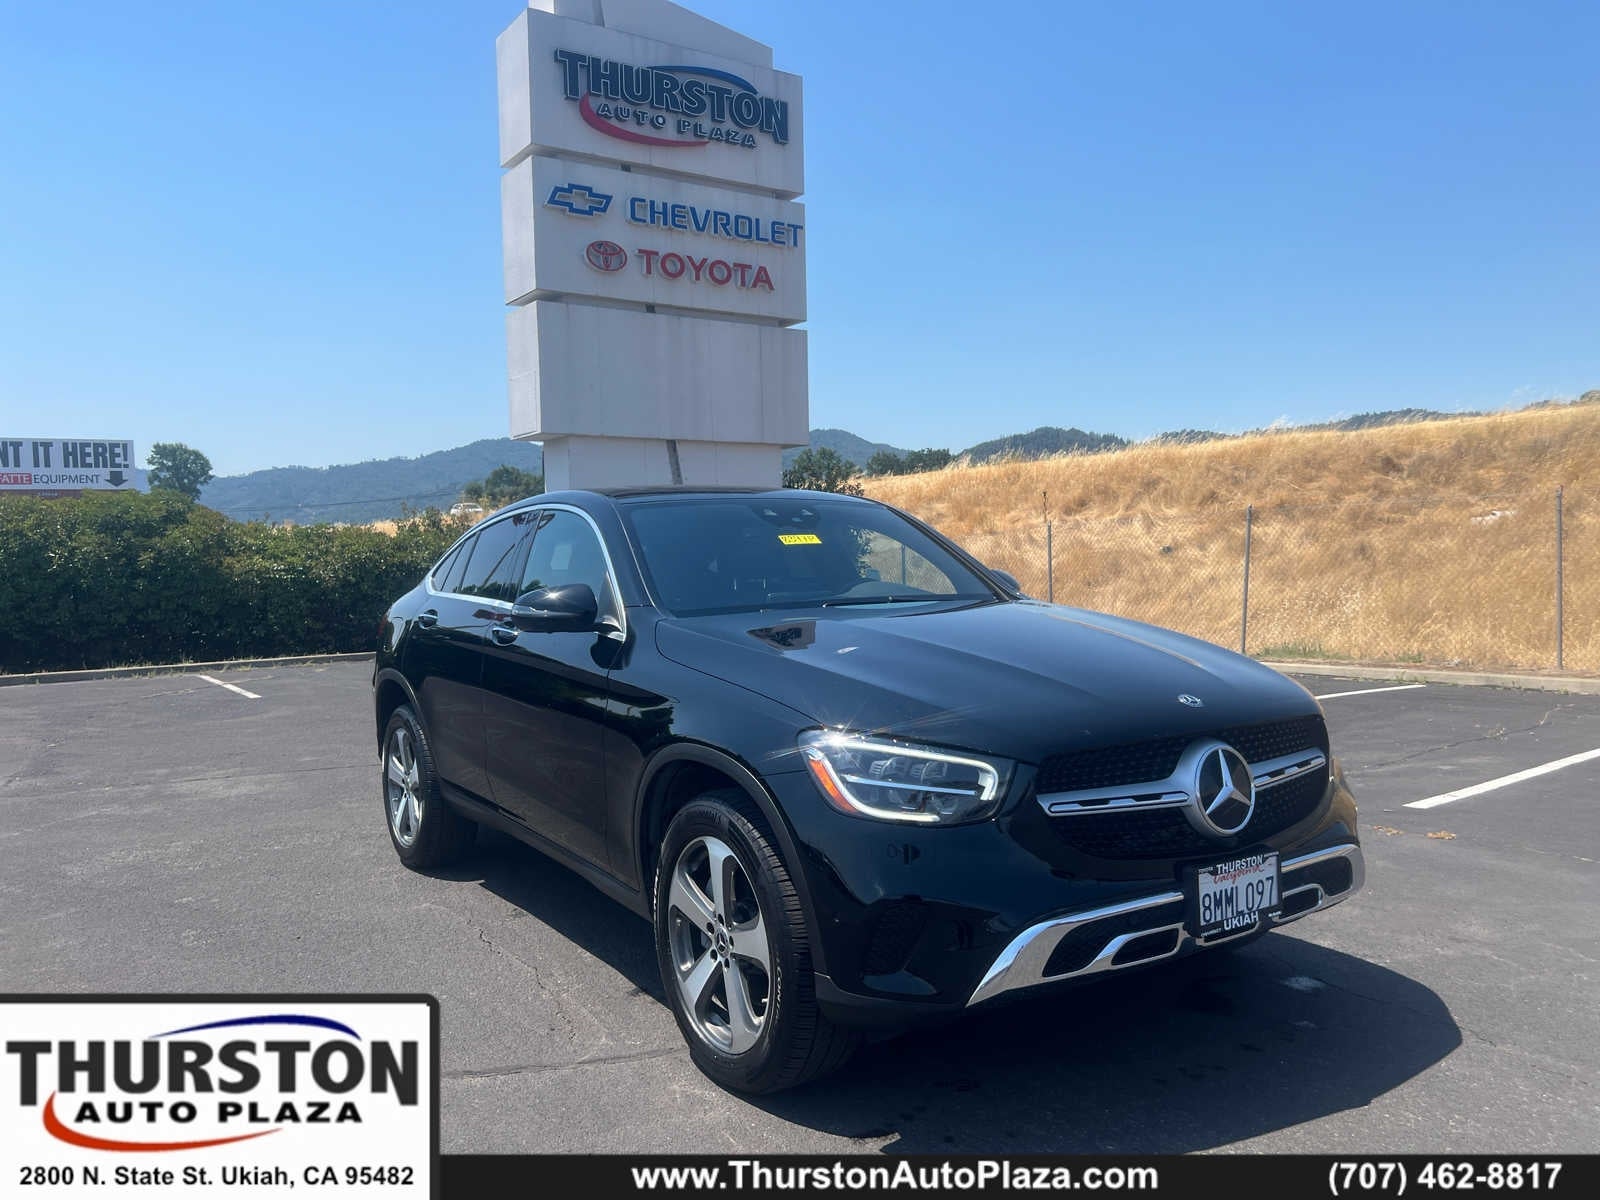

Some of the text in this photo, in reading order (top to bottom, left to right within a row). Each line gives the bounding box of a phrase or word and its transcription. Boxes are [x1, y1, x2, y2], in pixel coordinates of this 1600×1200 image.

[554, 48, 789, 145] THURSTON
[597, 102, 757, 148] AUTO PLAZA
[628, 197, 803, 248] CHEVROLET
[637, 248, 775, 291] TOYOTA
[32, 441, 53, 468] IT
[62, 442, 129, 469] HERE!
[33, 474, 100, 485] EQUIPMENT
[1216, 854, 1263, 874] THURSTON
[1202, 876, 1274, 923] 8MML097
[1223, 910, 1259, 931] UKIAH
